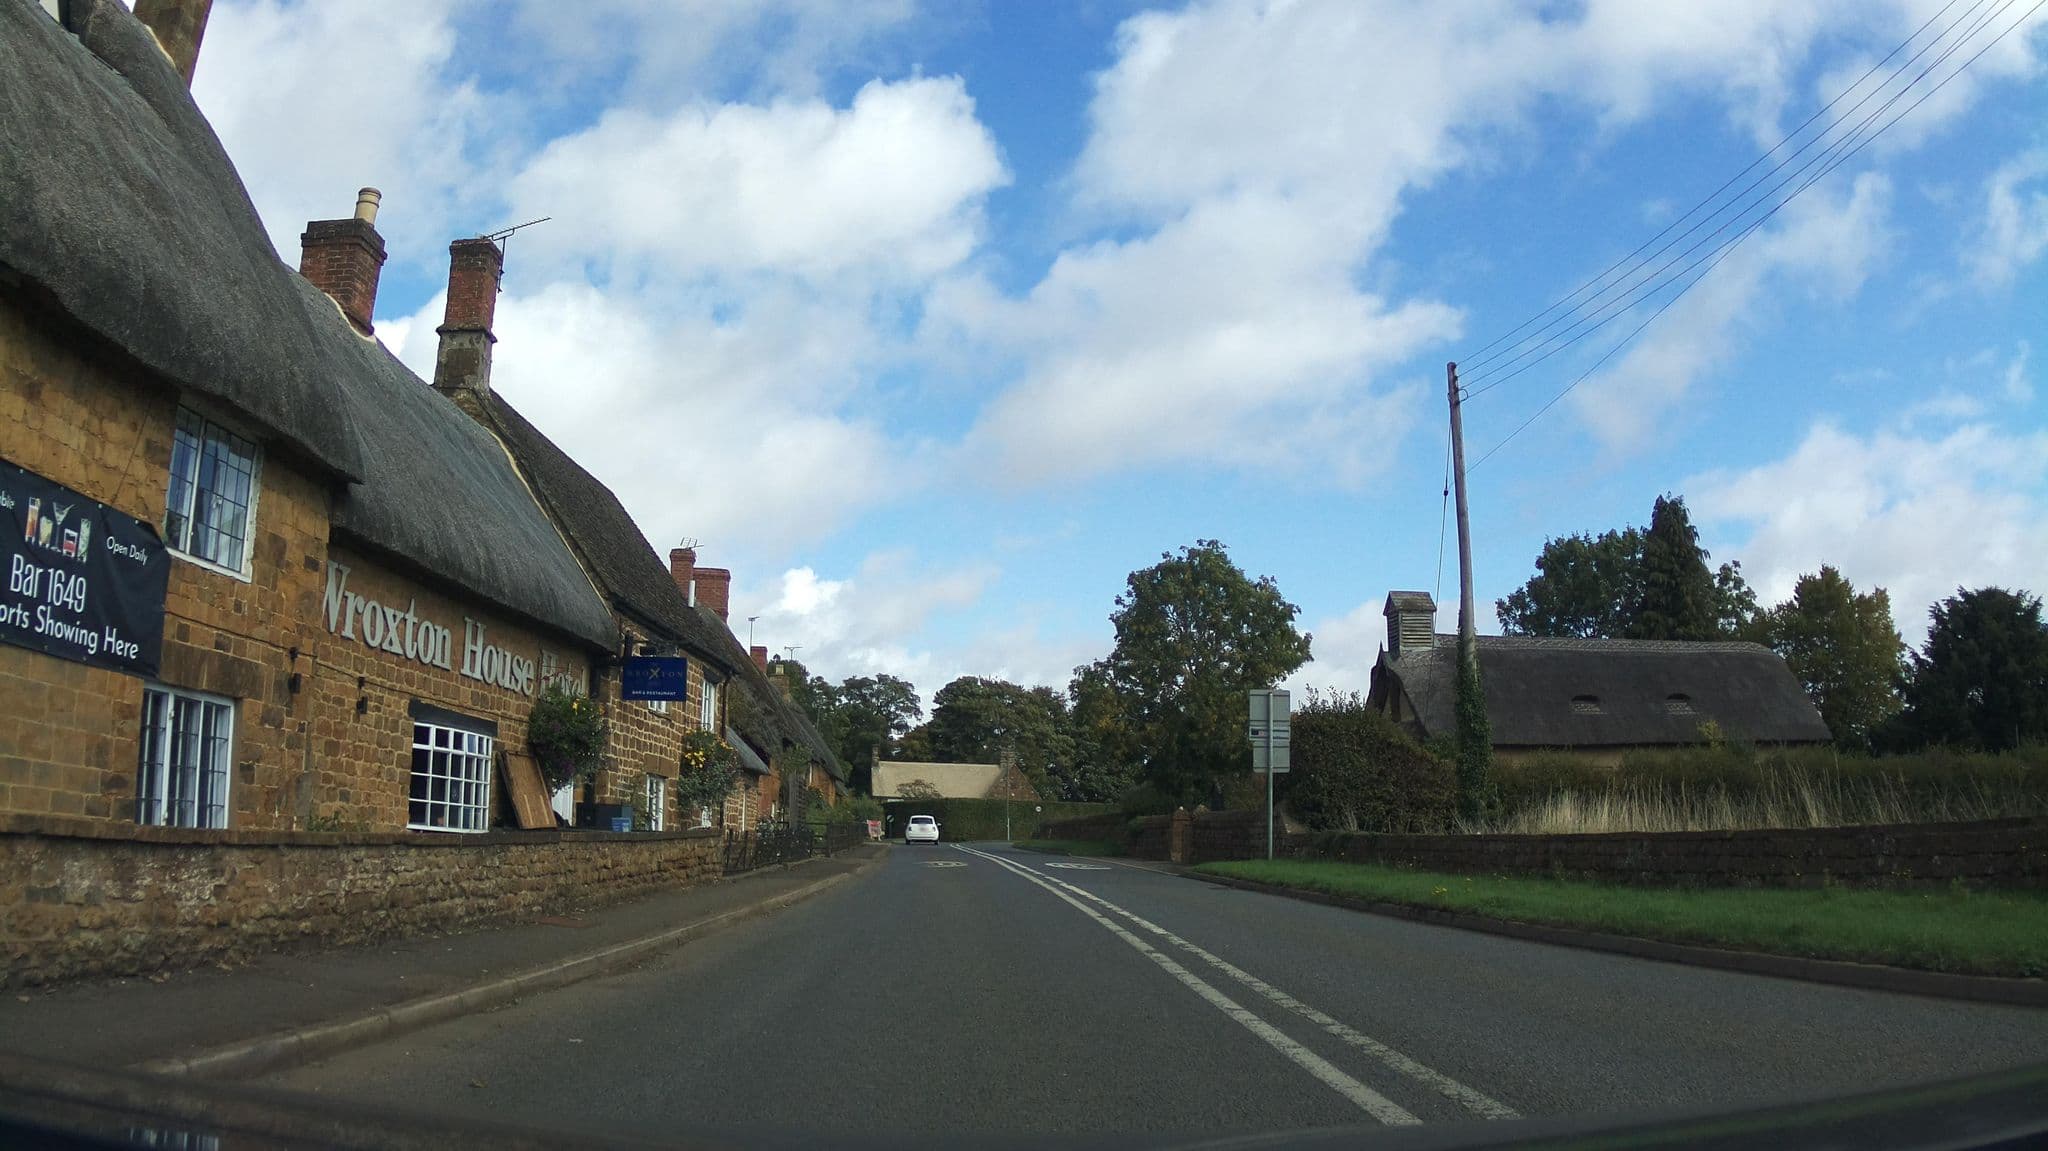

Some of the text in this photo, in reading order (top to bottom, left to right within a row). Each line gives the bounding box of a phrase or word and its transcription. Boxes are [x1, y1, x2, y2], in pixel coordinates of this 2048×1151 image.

[106, 536, 149, 566] Open Daily
[10, 553, 87, 613] Bar 1649
[34, 605, 99, 655] Showing
[103, 625, 139, 659] Here
[460, 616, 535, 696] House
